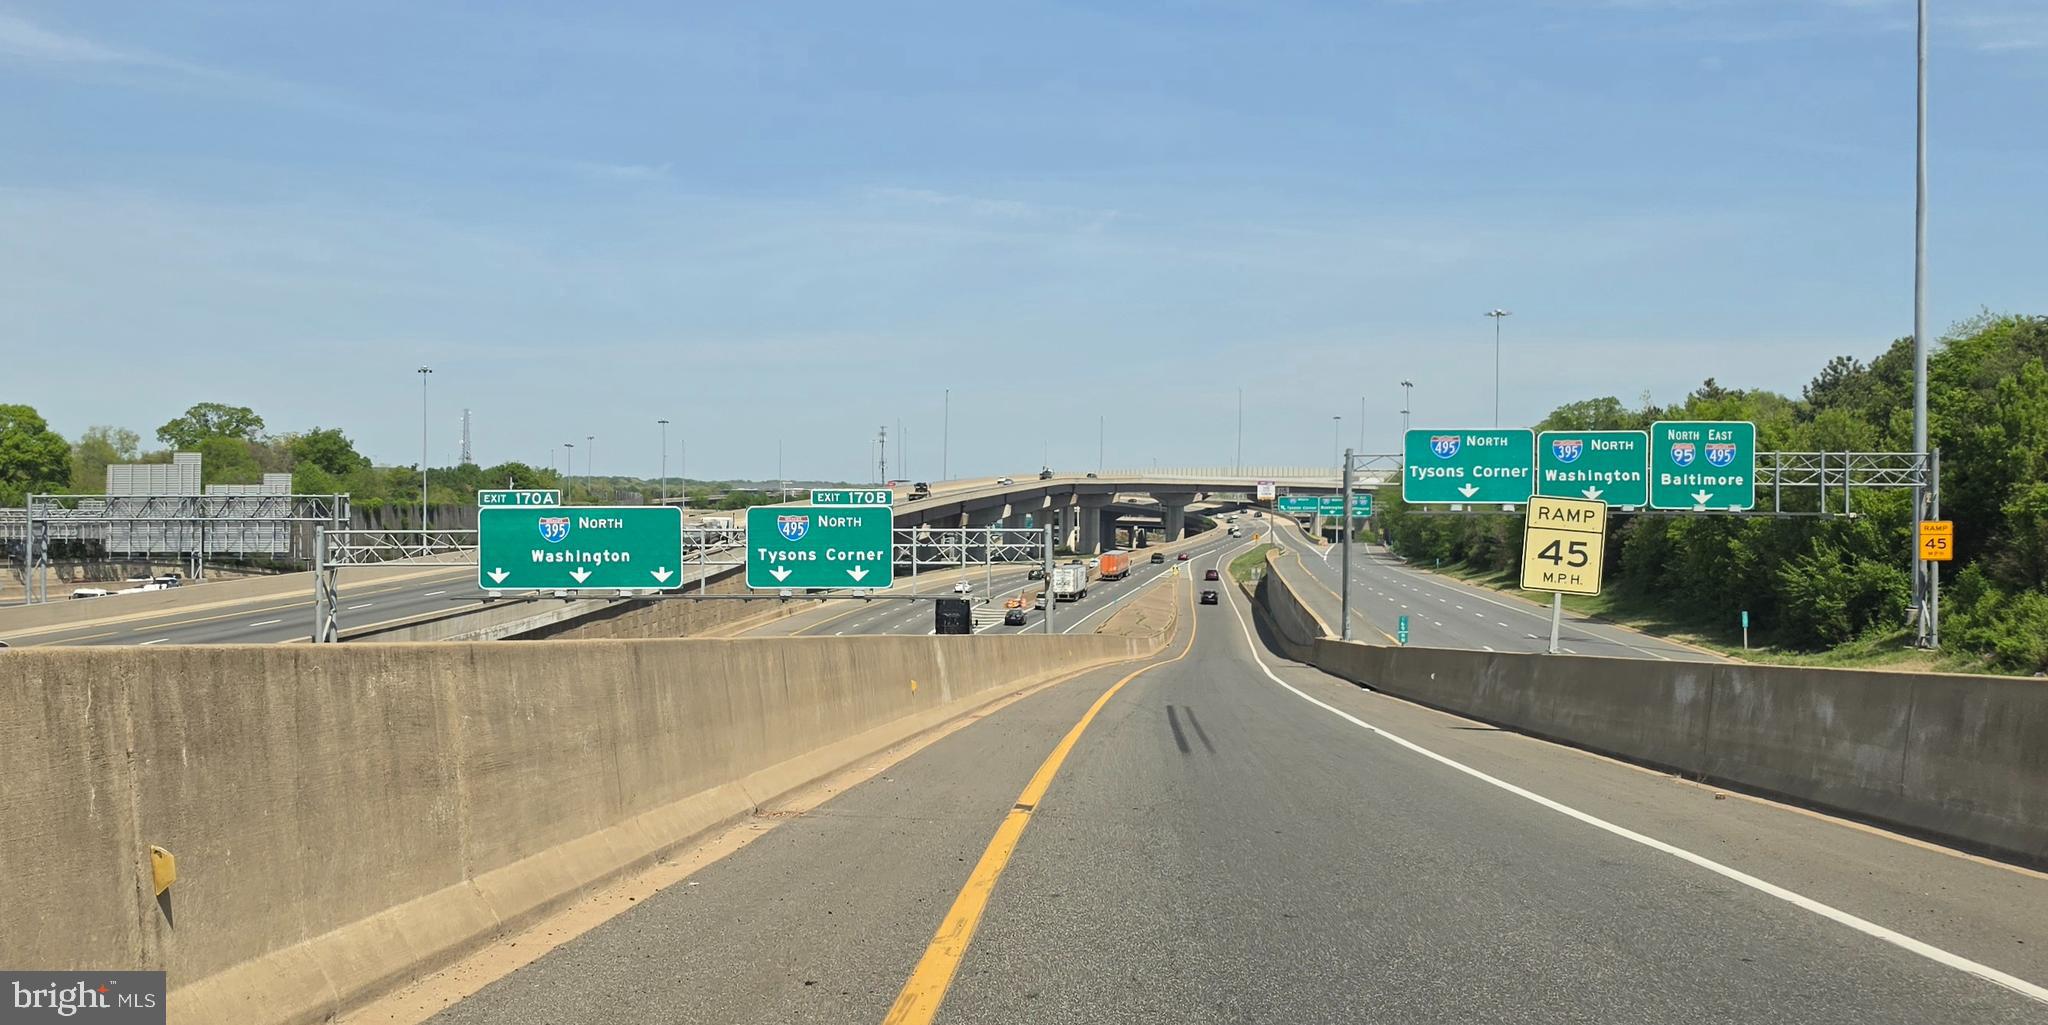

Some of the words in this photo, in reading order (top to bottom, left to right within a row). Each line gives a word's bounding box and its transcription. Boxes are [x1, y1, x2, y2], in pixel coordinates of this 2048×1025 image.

[1668, 429, 1700, 441] NORTH
[1708, 429, 1733, 441] EAST
[1435, 442, 1456, 454] 495
[1466, 435, 1508, 446] NORTH
[1558, 445, 1578, 459] 395
[1591, 439, 1634, 451] NORTH
[1674, 449, 1693, 462] 95
[1709, 449, 1731, 462] 495
[1409, 465, 1464, 480] Tysons
[1472, 465, 1529, 477] Corner
[1545, 469, 1640, 485] Washington
[1661, 473, 1744, 486] Baltimore
[484, 494, 506, 503] EXIT
[515, 493, 554, 504] 170A
[817, 493, 840, 502] EXIT
[848, 492, 887, 504] 170B
[1538, 506, 1595, 523] RAMP
[545, 524, 565, 538] 395
[579, 517, 623, 529] NORTH
[782, 522, 804, 536] 495
[818, 515, 862, 527] NORTH
[1925, 538, 1947, 549] 45
[531, 549, 630, 566] Washington
[758, 548, 817, 564] Tysons
[826, 548, 884, 561] Corner
[1537, 539, 1588, 568] 45
